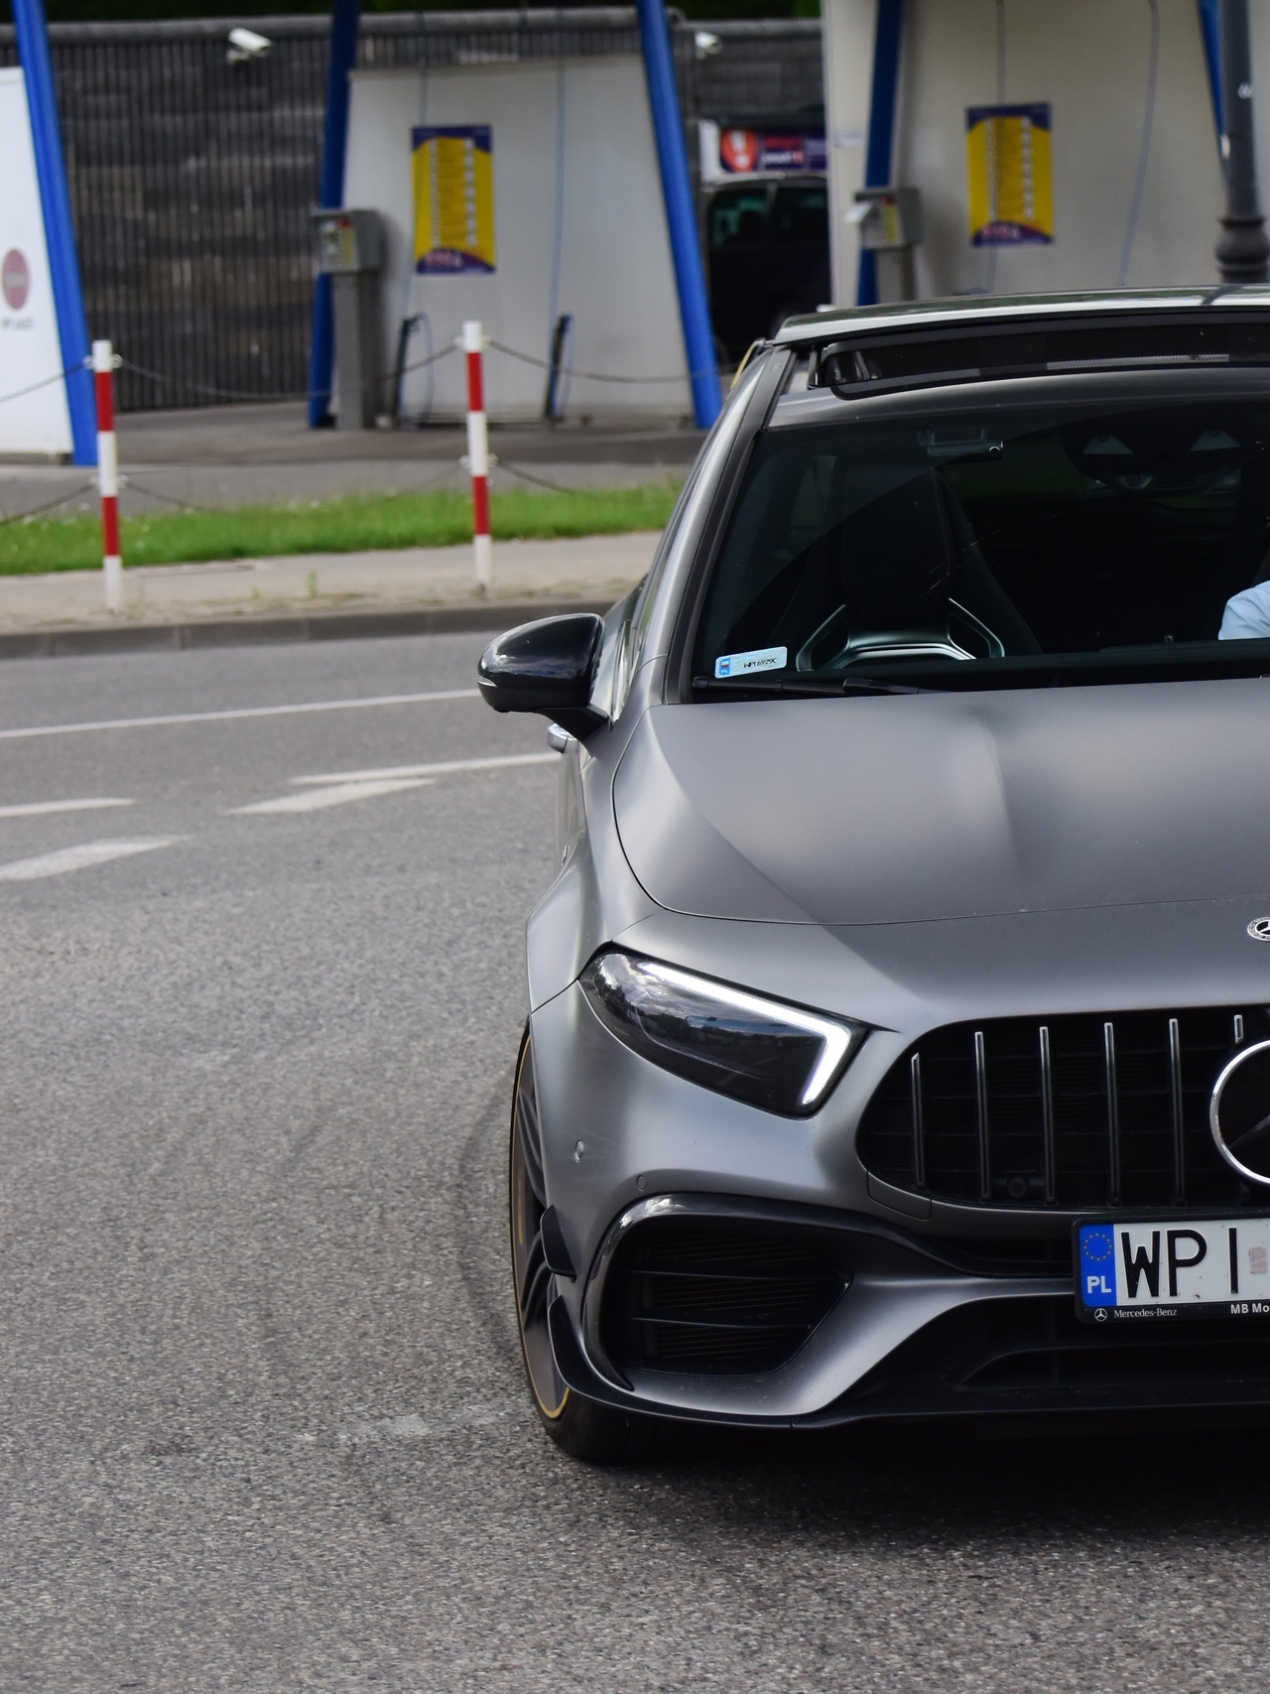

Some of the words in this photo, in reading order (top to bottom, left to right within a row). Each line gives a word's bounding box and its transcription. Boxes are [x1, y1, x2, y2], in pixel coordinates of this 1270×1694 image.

[1120, 1228, 1238, 1298] WPI
[1087, 1275, 1112, 1294] PL
[1113, 1307, 1178, 1319] Mercedes-Benz
[1230, 1303, 1249, 1314] MB
